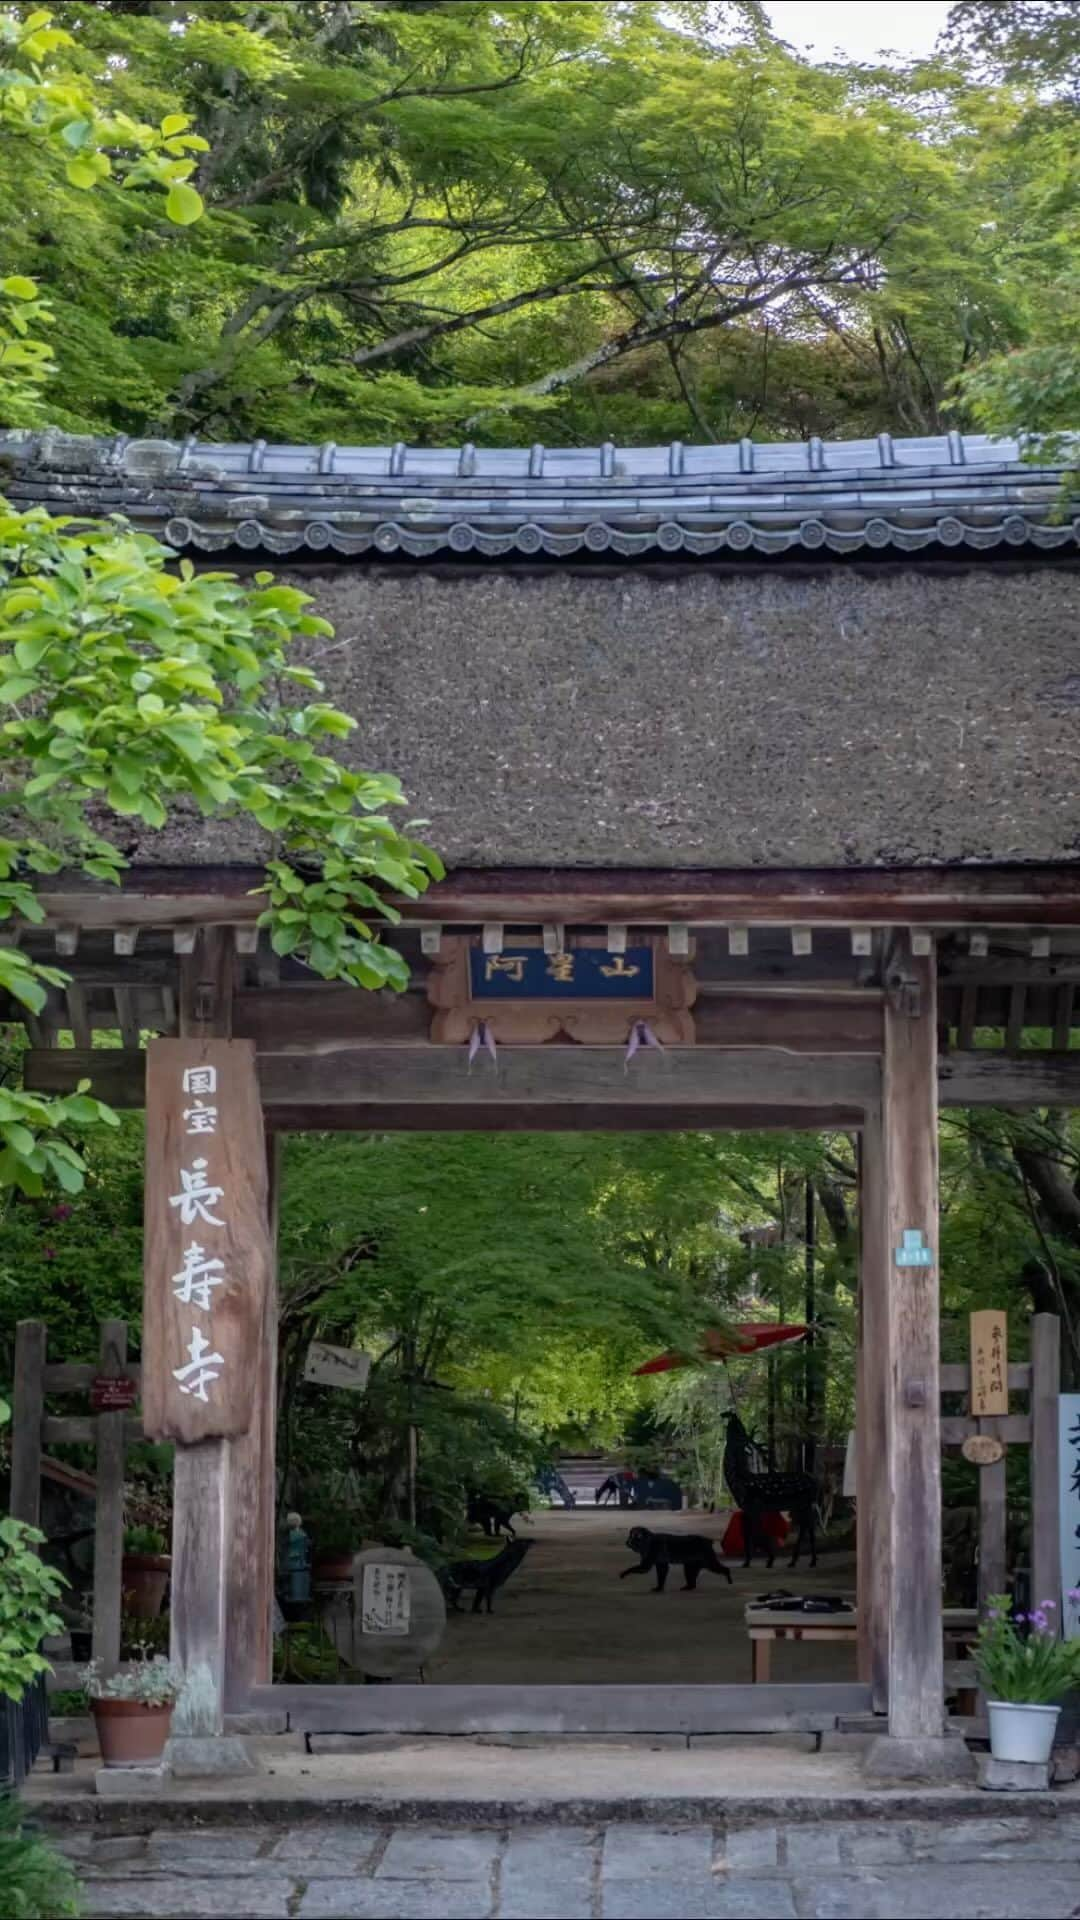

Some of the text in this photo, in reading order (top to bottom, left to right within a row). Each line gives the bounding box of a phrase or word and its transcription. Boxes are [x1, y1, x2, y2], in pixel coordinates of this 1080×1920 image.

[485, 953, 640, 981] 阿星山
[168, 1065, 226, 1402] 国宝 長寿寺
